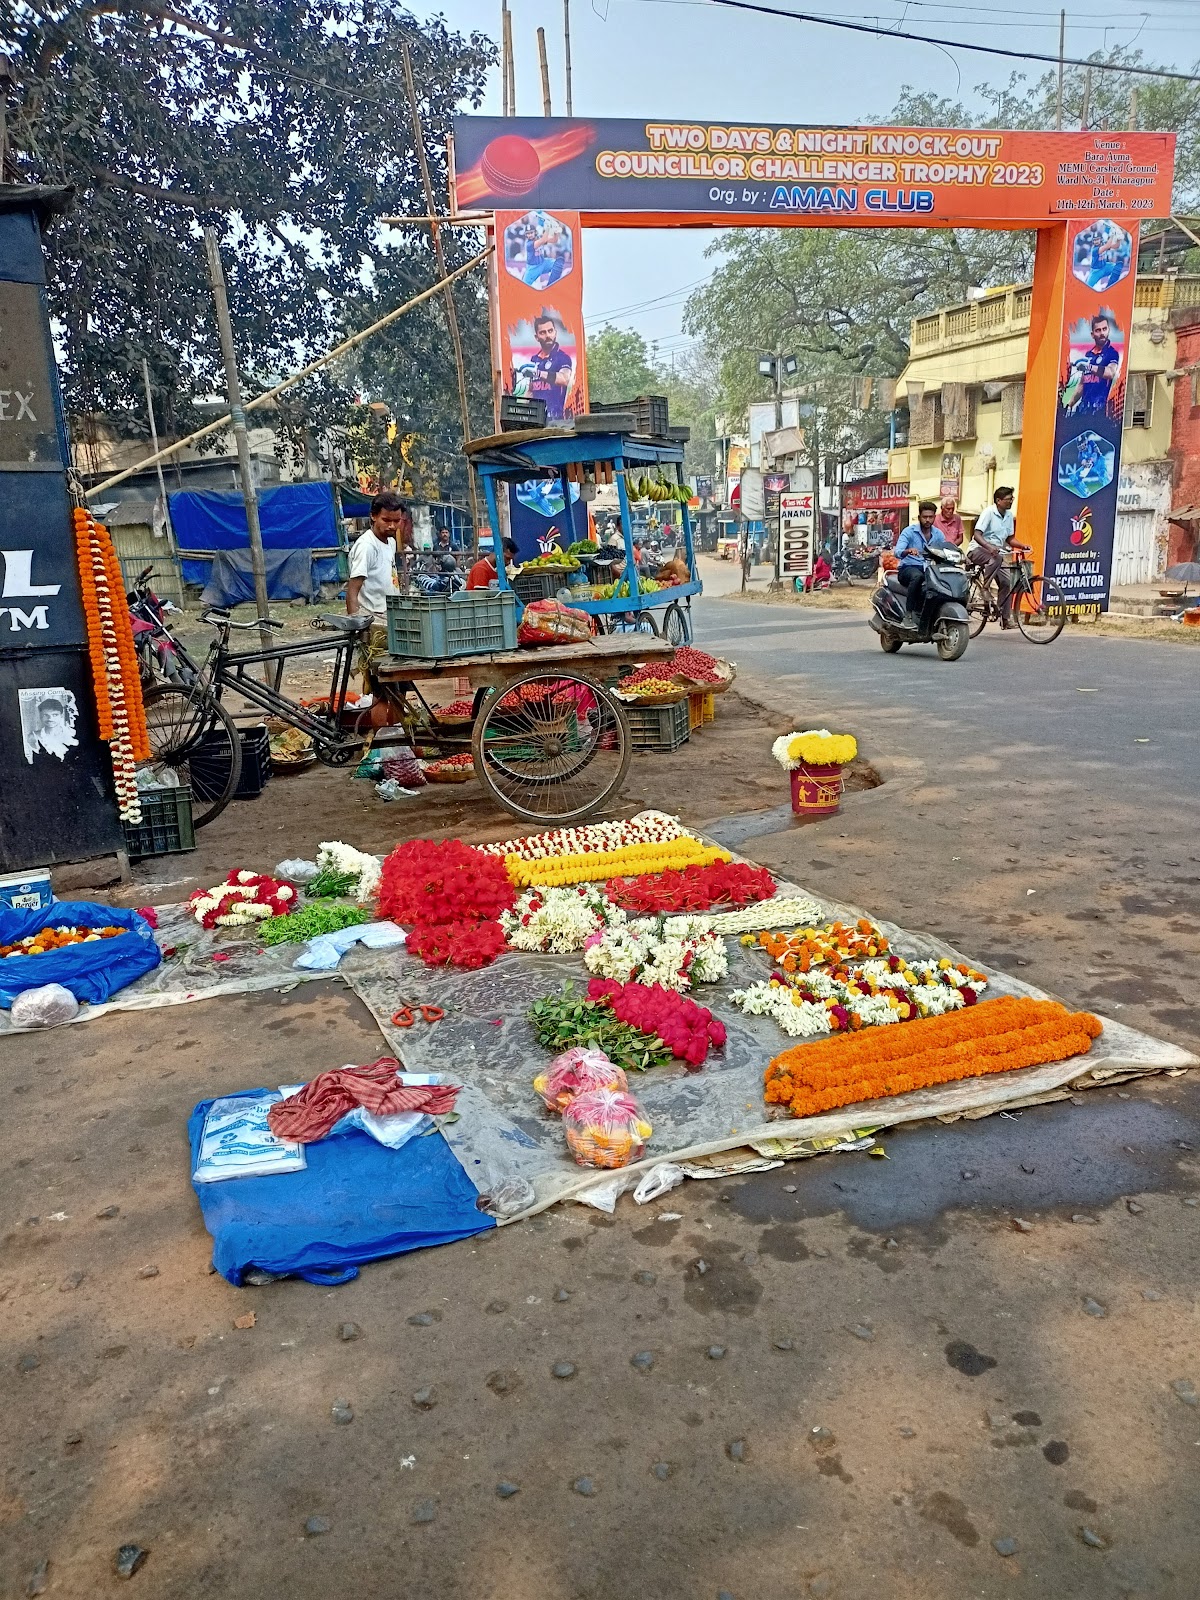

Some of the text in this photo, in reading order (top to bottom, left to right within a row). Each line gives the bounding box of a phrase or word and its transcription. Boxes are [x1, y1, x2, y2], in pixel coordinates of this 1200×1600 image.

[647, 125, 1002, 160] TWO DAYS & NIGHT KNOCK-OUT
[1093, 139, 1120, 150] Venue
[1084, 151, 1105, 162] Bara
[596, 152, 1045, 187] COUNCILLOR CHALLENGER TROPHY 2023
[1057, 163, 1160, 174] MEMU Carshed Ground,
[1056, 175, 1079, 185] Ward
[1080, 175, 1108, 186] No-31,
[1092, 187, 1115, 197] Date
[708, 186, 739, 205] Org.
[742, 187, 761, 206] by
[769, 186, 859, 211] AMAN
[864, 187, 935, 212] CLUB
[1056, 199, 1155, 210] 11th-12th March, 2023
[861, 485, 879, 500] PEN
[785, 498, 796, 507] THIS
[796, 498, 807, 507] WAY
[781, 509, 812, 519] ANAND
[783, 519, 810, 573] LODGE
[1060, 551, 1089, 560] Decorated
[1090, 550, 1097, 560] by
[1055, 561, 1100, 576] MAA KALI
[1049, 574, 1104, 590] DECORATOR
[1046, 592, 1106, 602] Bara yma, Kharagpur
[15, 901, 39, 909] Berger
